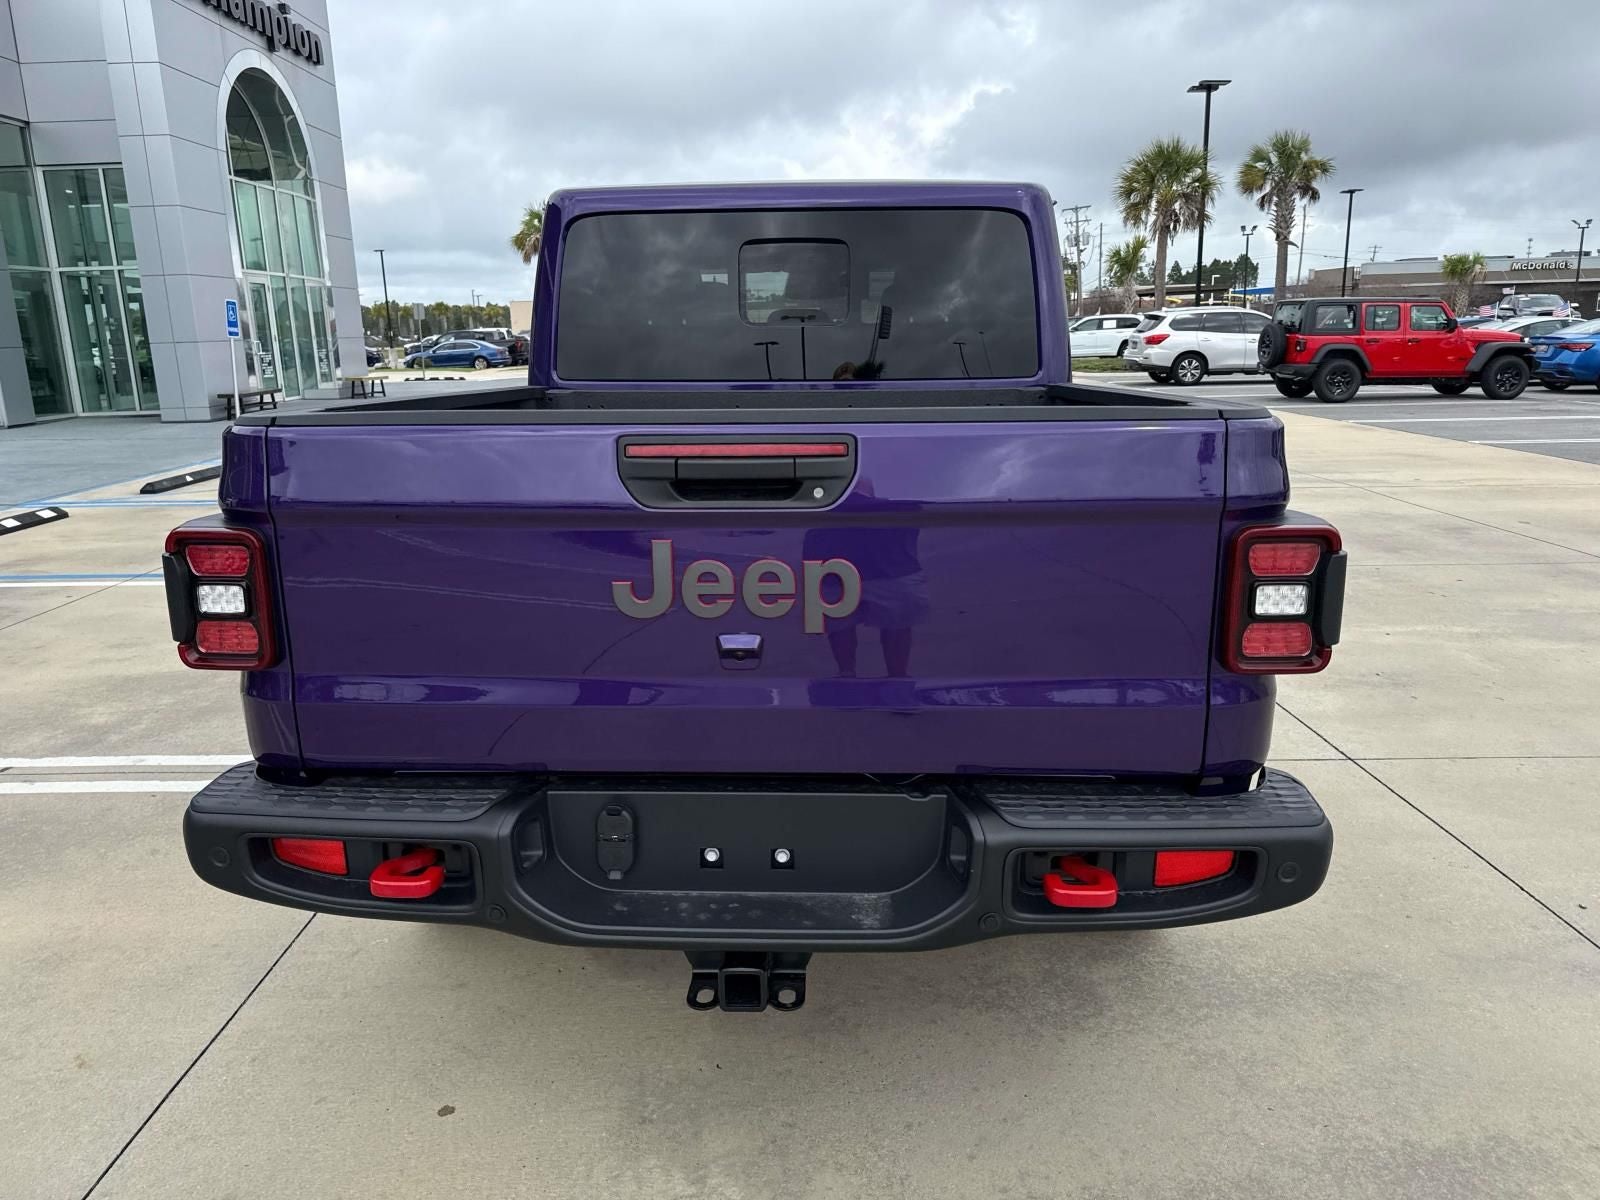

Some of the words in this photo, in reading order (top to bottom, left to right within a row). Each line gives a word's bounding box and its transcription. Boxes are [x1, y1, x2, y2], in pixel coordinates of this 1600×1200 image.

[202, 0, 324, 65] ampion
[1511, 261, 1574, 270] McDonald's
[612, 539, 862, 634] Jeep
